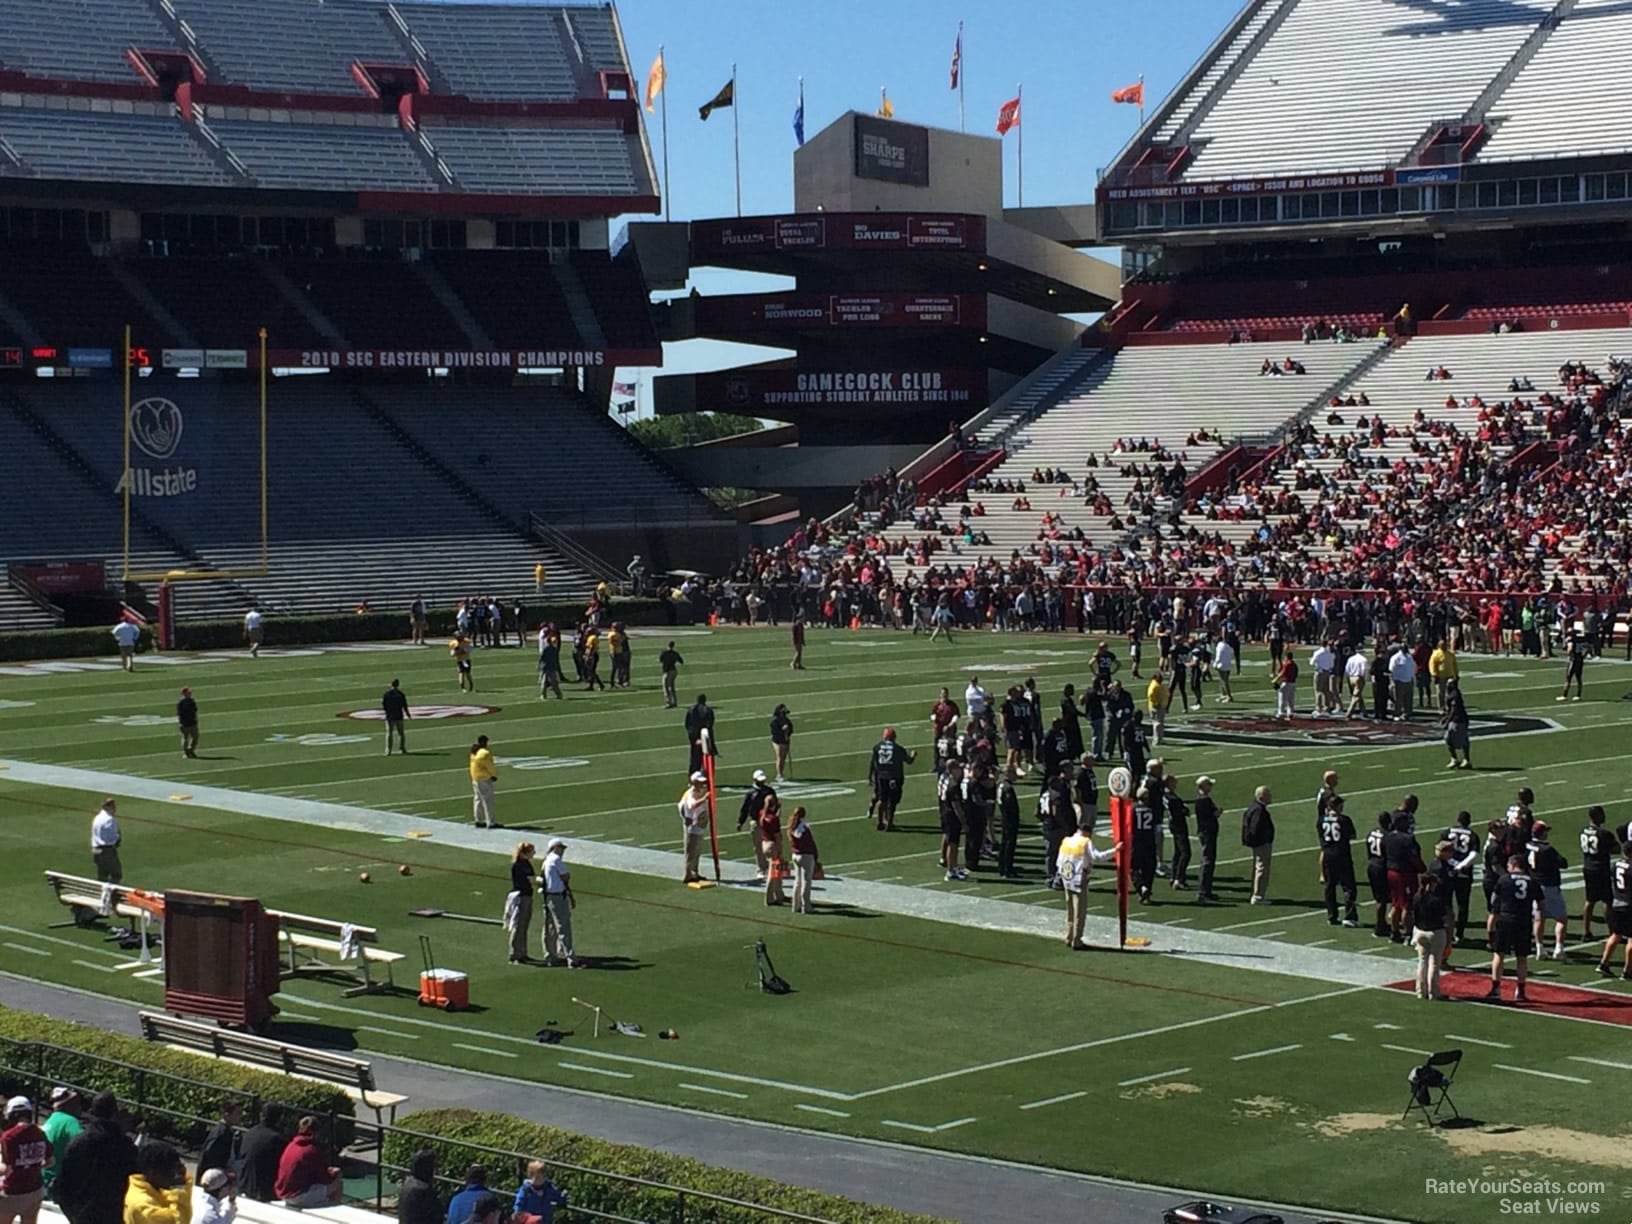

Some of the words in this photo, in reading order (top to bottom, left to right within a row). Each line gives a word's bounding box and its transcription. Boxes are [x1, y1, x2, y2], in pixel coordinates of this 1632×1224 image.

[863, 143, 905, 160] SHARPE
[854, 231, 901, 240] DAVIES
[765, 309, 822, 319] NORWOOD
[302, 352, 340, 366] 2010
[346, 352, 373, 366] SEC
[380, 352, 439, 366] EASTERN
[444, 352, 510, 366] DIVISION
[518, 352, 604, 365] CHAMPIONS
[797, 373, 893, 390] GAMECOCK
[902, 372, 941, 389] CLUB
[764, 391, 822, 403] SUPPORTING
[826, 390, 870, 402] STUDENT
[874, 390, 918, 402] ATHLETES
[923, 390, 948, 401] SINCE
[113, 466, 197, 496] Allstate
[1136, 812, 1152, 830] 12
[1322, 822, 1341, 842] 26
[1515, 879, 1527, 899] 3
